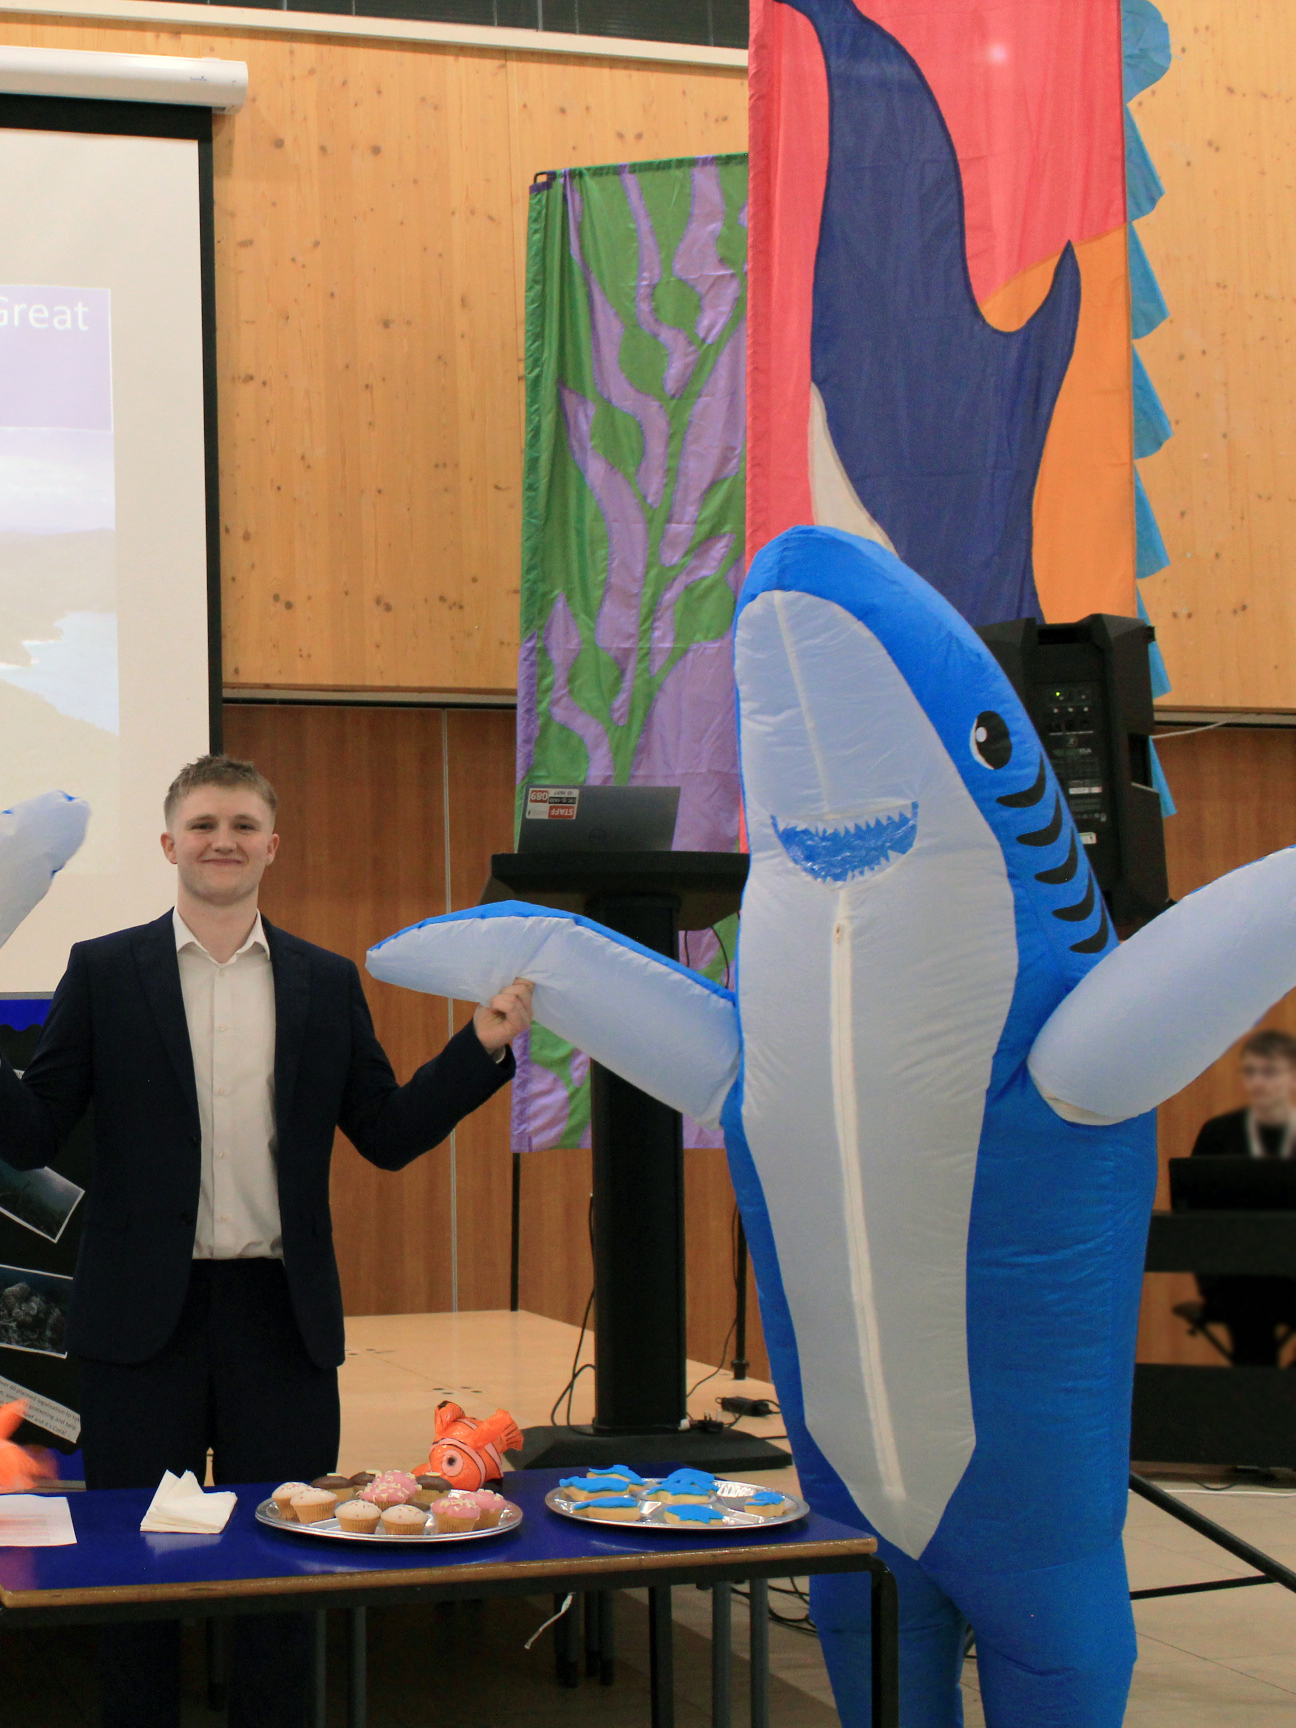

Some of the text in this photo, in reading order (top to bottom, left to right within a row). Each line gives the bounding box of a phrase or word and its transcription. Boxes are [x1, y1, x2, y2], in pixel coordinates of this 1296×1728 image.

[530, 792, 548, 801] 089
[550, 808, 575, 816] STAFF
[17, 1388, 37, 1402] planned
